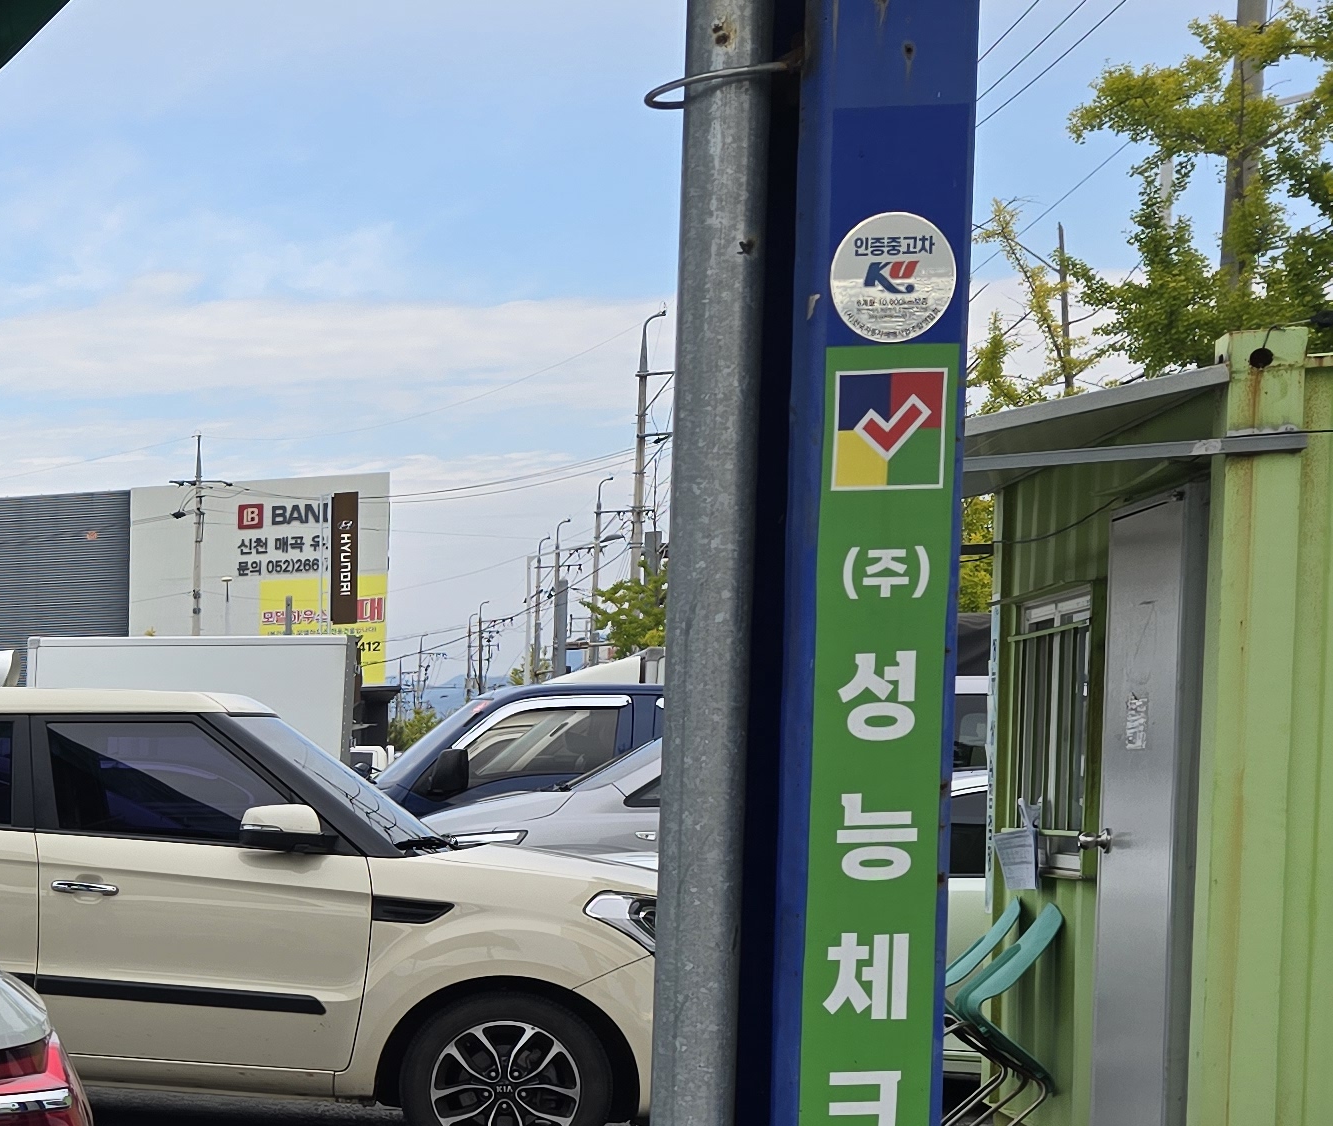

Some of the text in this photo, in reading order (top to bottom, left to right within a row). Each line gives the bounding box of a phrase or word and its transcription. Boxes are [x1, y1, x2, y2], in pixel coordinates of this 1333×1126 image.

[854, 235, 935, 257] 인증중고차
[237, 537, 269, 556] 신천
[274, 535, 305, 554] 매곡
[237, 557, 329, 577] 문의 052)266
[339, 533, 353, 596] HYUNDAI
[843, 545, 930, 600] (주)
[496, 1085, 513, 1093] KIA
